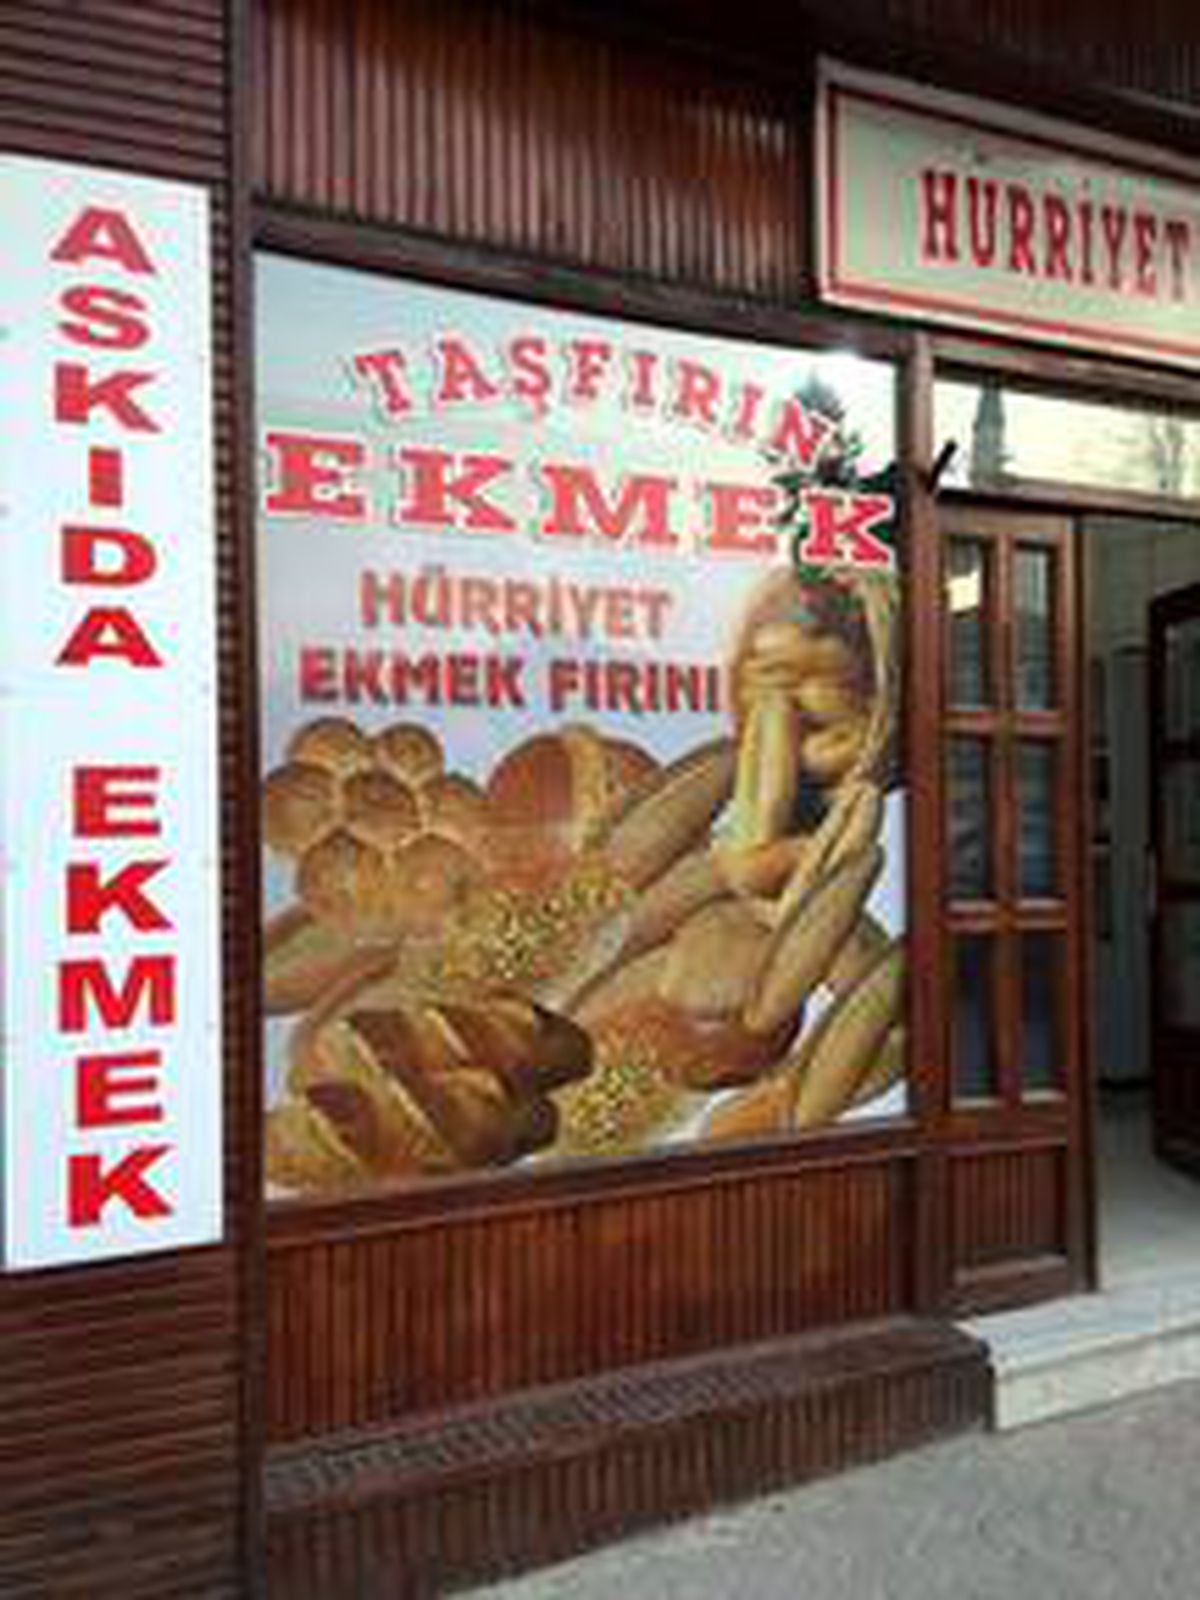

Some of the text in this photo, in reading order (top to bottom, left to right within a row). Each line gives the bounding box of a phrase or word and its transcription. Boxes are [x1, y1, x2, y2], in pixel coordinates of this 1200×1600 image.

[264, 431, 896, 567] EKMEK
[49, 205, 176, 1226] ASKIDA EKMEK
[298, 648, 722, 714] EKMEK FIRINI
